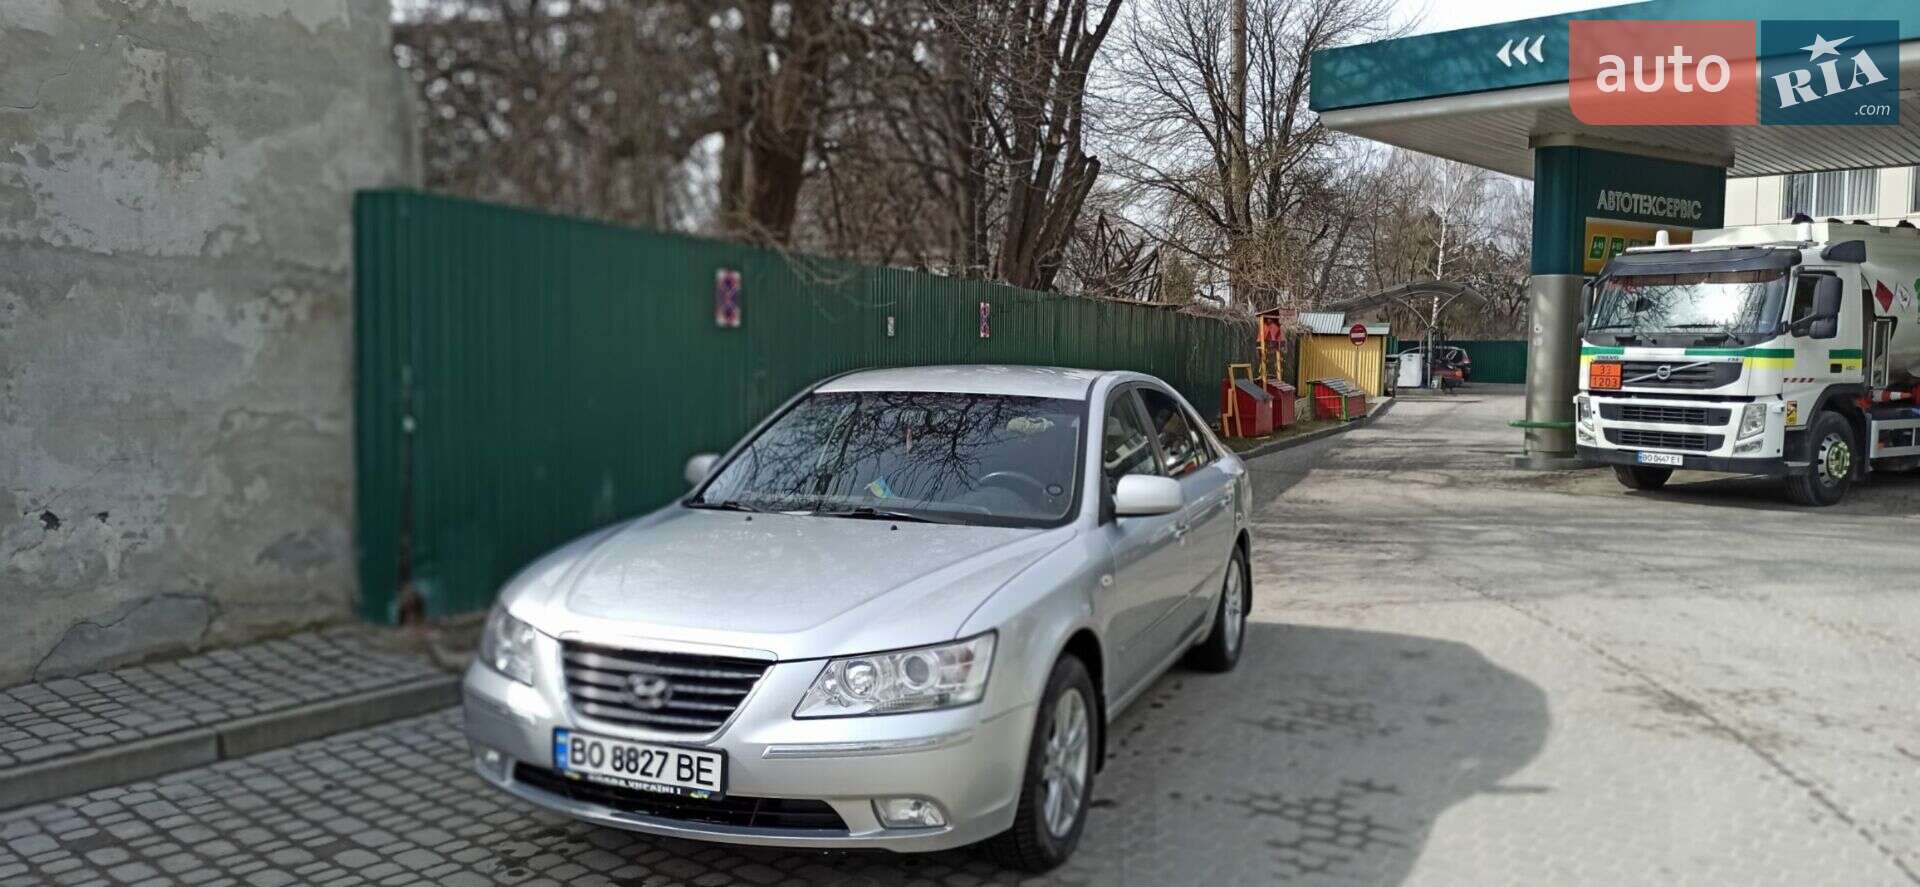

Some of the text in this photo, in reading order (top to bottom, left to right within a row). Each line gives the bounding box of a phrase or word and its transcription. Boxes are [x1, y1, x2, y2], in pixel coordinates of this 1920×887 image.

[1597, 189, 1702, 220] АВТОТЕХСЕРВІС
[1593, 375, 1618, 387] 1203
[571, 738, 605, 769] BO
[611, 745, 669, 778] 8827
[676, 753, 714, 786] BE
